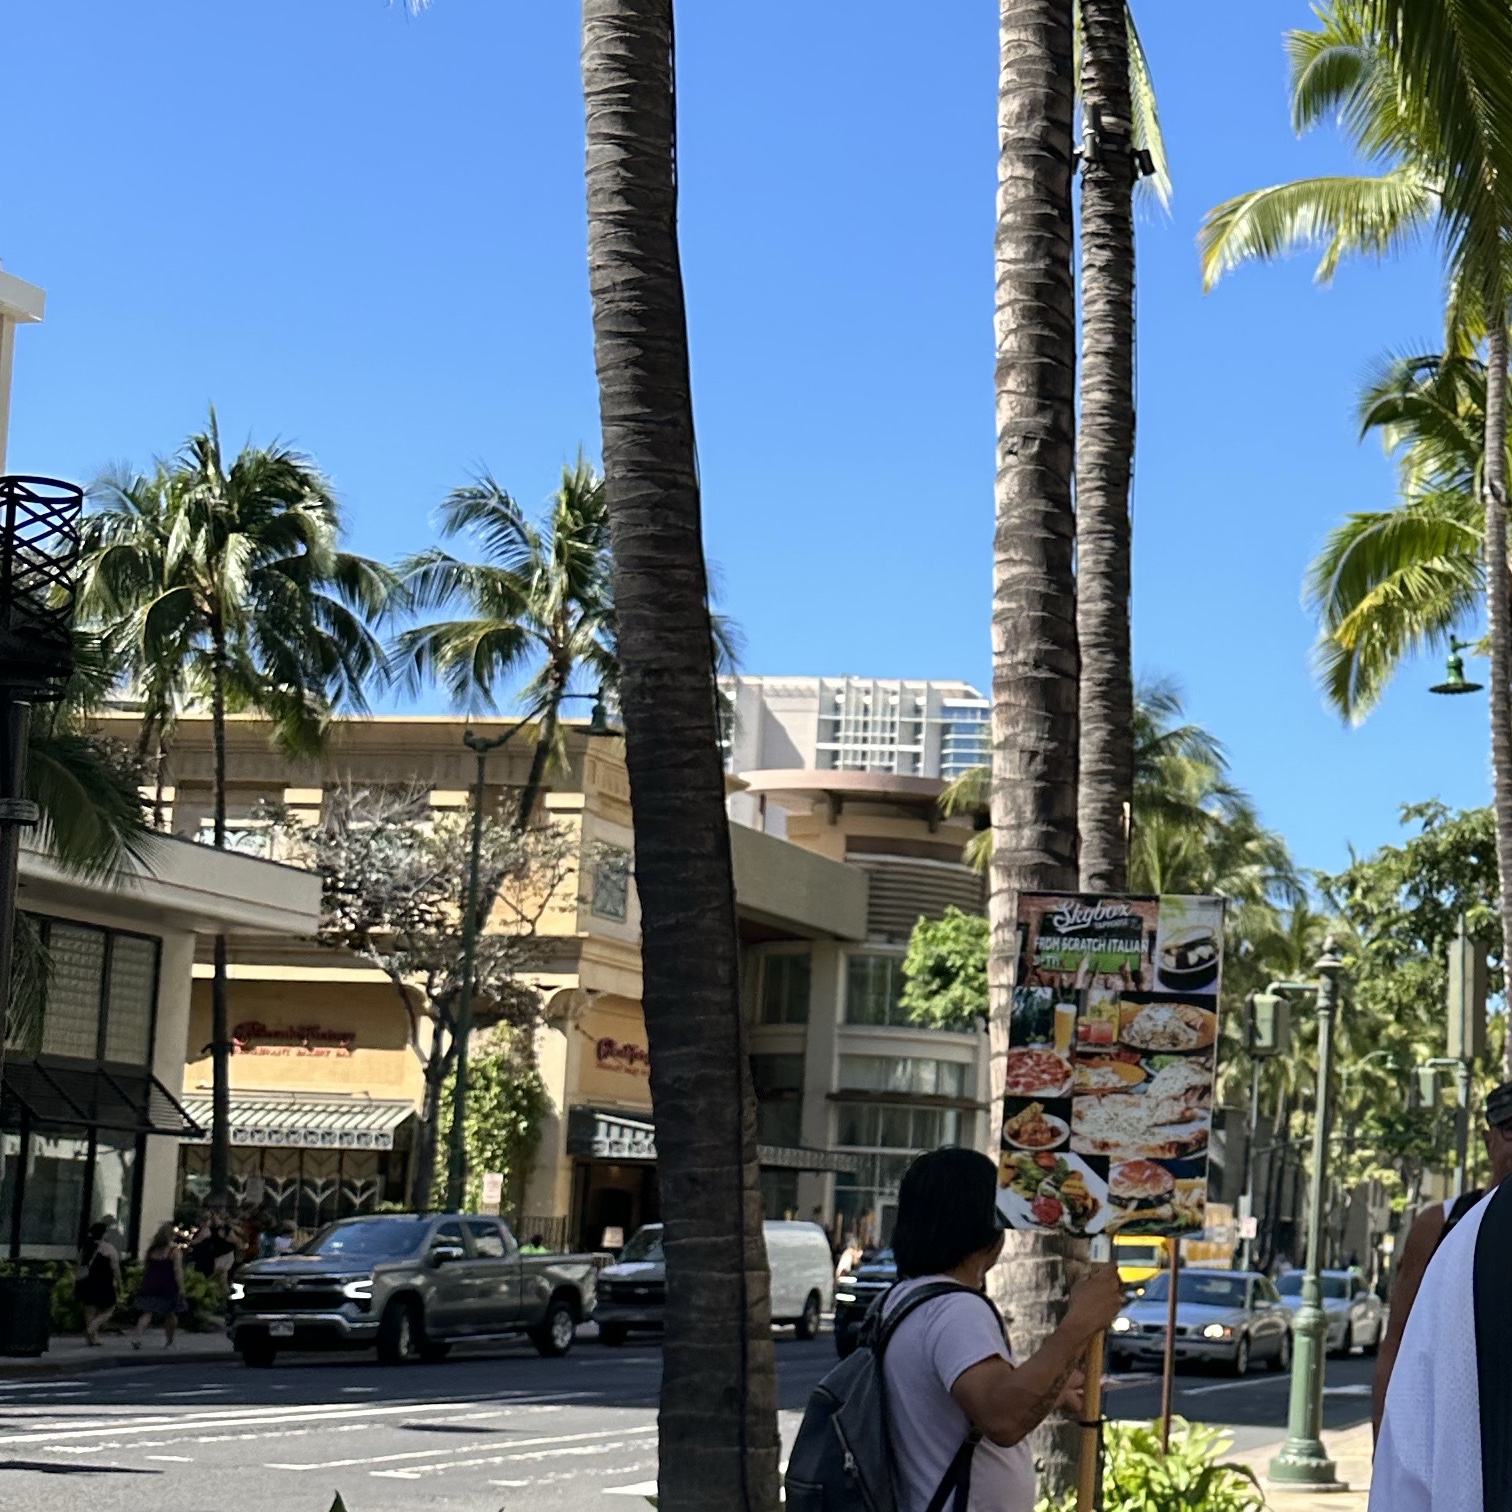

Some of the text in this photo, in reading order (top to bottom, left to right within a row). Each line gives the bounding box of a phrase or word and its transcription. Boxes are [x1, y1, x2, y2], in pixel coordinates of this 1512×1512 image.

[1053, 899, 1131, 934] Skybox
[1034, 936, 1060, 951] FROM
[1061, 937, 1106, 952] SCRATCH
